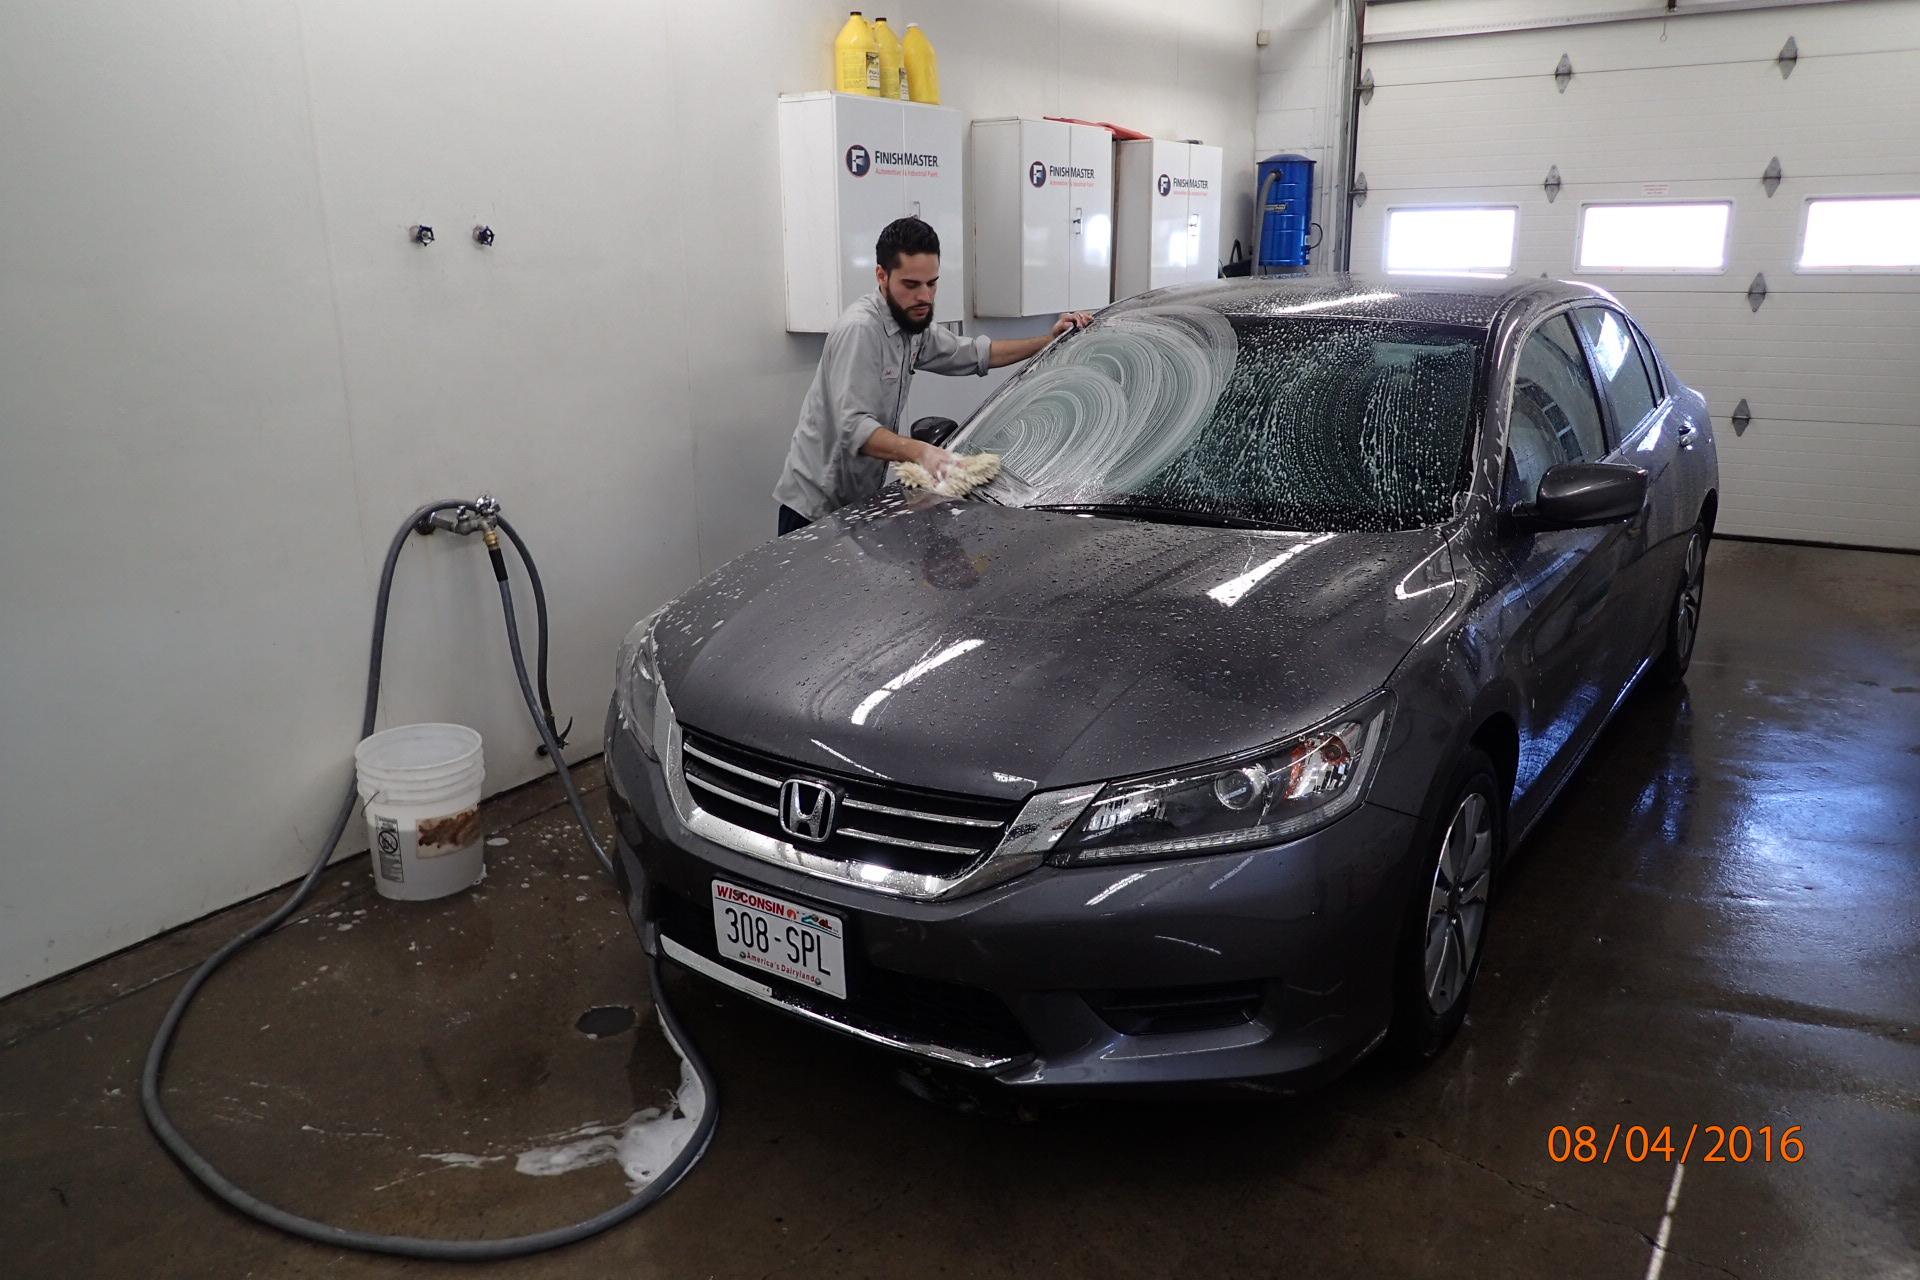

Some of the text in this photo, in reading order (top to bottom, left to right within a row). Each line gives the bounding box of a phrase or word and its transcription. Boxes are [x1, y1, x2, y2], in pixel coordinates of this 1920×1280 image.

[717, 885, 784, 916] WISCONSIN
[725, 907, 831, 976] 308-SPL
[746, 952, 816, 983] America's Dairyland
